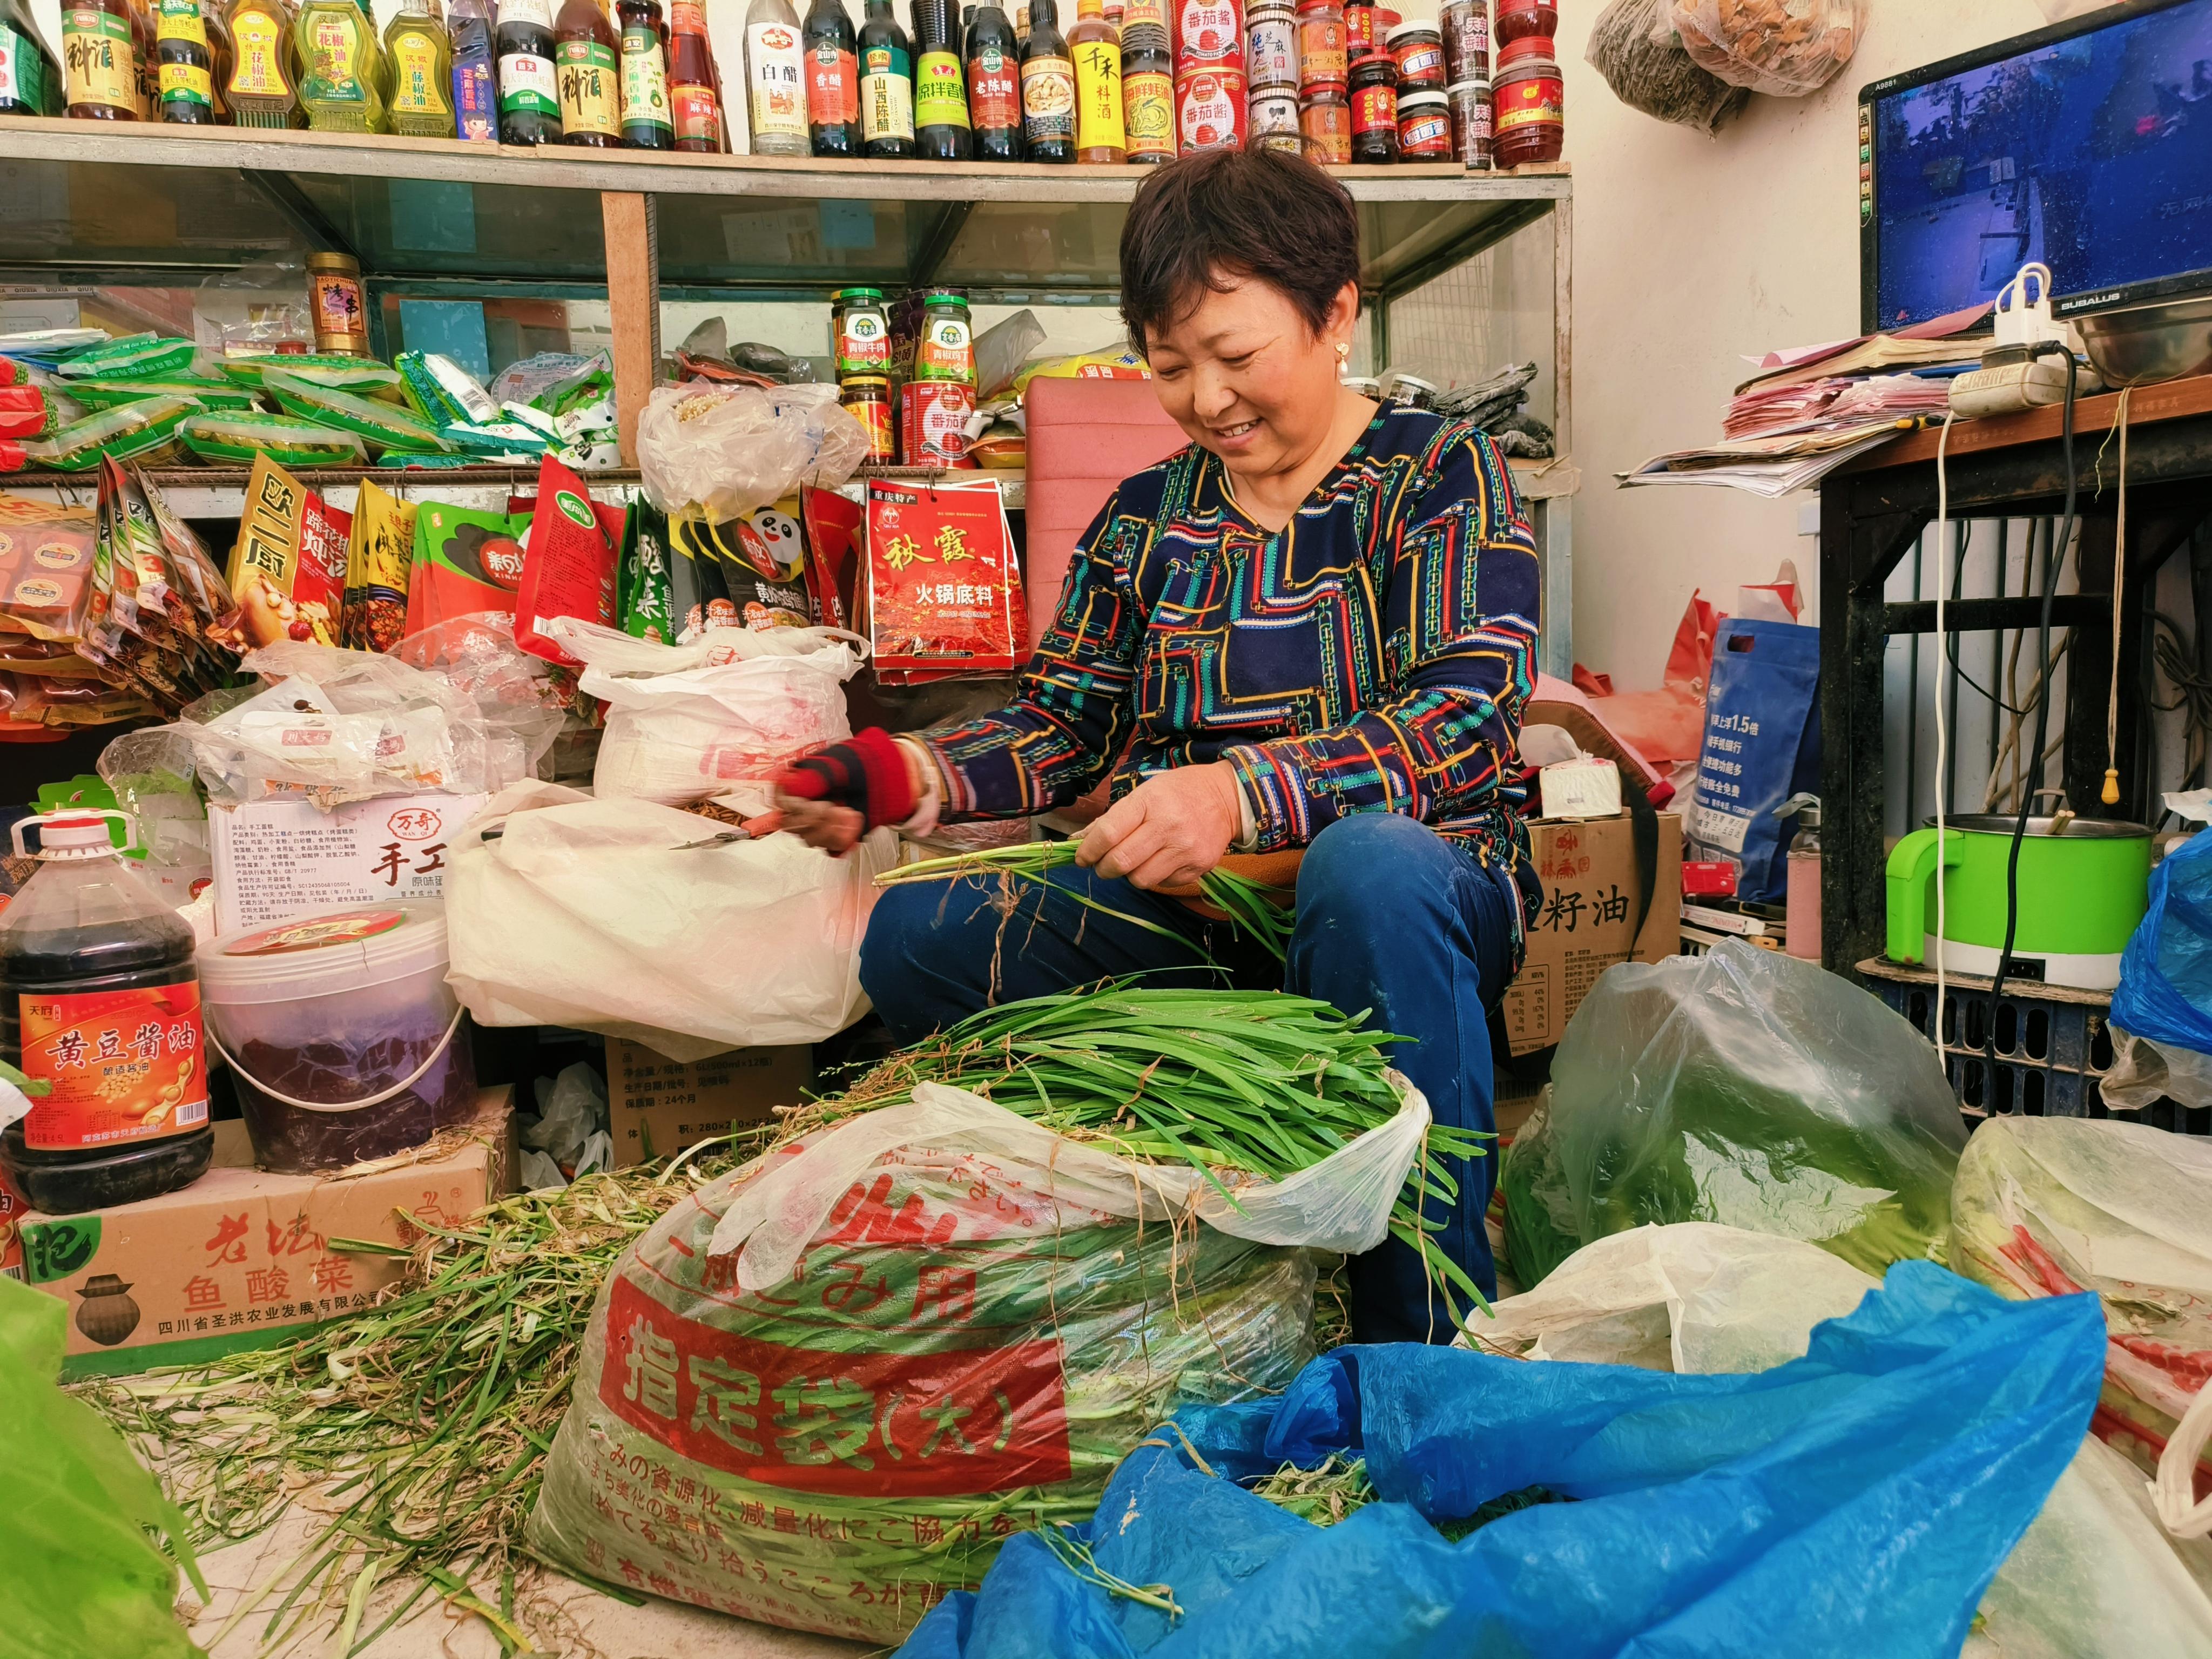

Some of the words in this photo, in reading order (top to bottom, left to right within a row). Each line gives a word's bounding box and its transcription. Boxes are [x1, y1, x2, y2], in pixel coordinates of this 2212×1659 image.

[1188, 10, 1230, 28] 番茄酱
[318, 33, 345, 47] 花椒
[67, 35, 114, 86] 料酒
[815, 49, 838, 60] 金山寺
[982, 56, 1003, 66] 金山寺
[1081, 47, 1120, 81] 千禾
[1405, 50, 1442, 73] 甜面酱
[251, 52, 266, 87] 花椒油
[762, 63, 798, 84] 白醋
[815, 72, 842, 87] 香醋
[975, 78, 1013, 95] 老陈醋
[1875, 79, 1897, 91] A9881
[562, 66, 602, 116] 料酒
[1124, 83, 1170, 103] 海鲜蚝油
[874, 77, 890, 132] 山西陈醋
[1096, 84, 1111, 120] 料酒
[1186, 104, 1227, 124] 番茄酱
[1405, 121, 1446, 145] 甜面酱
[2061, 292, 2120, 311] BUBALUS
[855, 325, 878, 335] 吉香居
[941, 332, 962, 343] 吉香居
[848, 342, 886, 354] 青椒牛肉
[933, 349, 969, 362] 青椒鸡丁
[874, 490, 916, 504] 重庆特产
[881, 525, 976, 572] 秋霞
[915, 583, 994, 607] 火锅底料
[396, 812, 434, 831] 万奇
[370, 842, 448, 887] 手工
[1527, 884, 1630, 933] 籽油
[29, 1006, 53, 1016] 天府
[103, 1062, 150, 1076] 酿造酱油
[182, 1256, 355, 1314] 鱼酸菜
